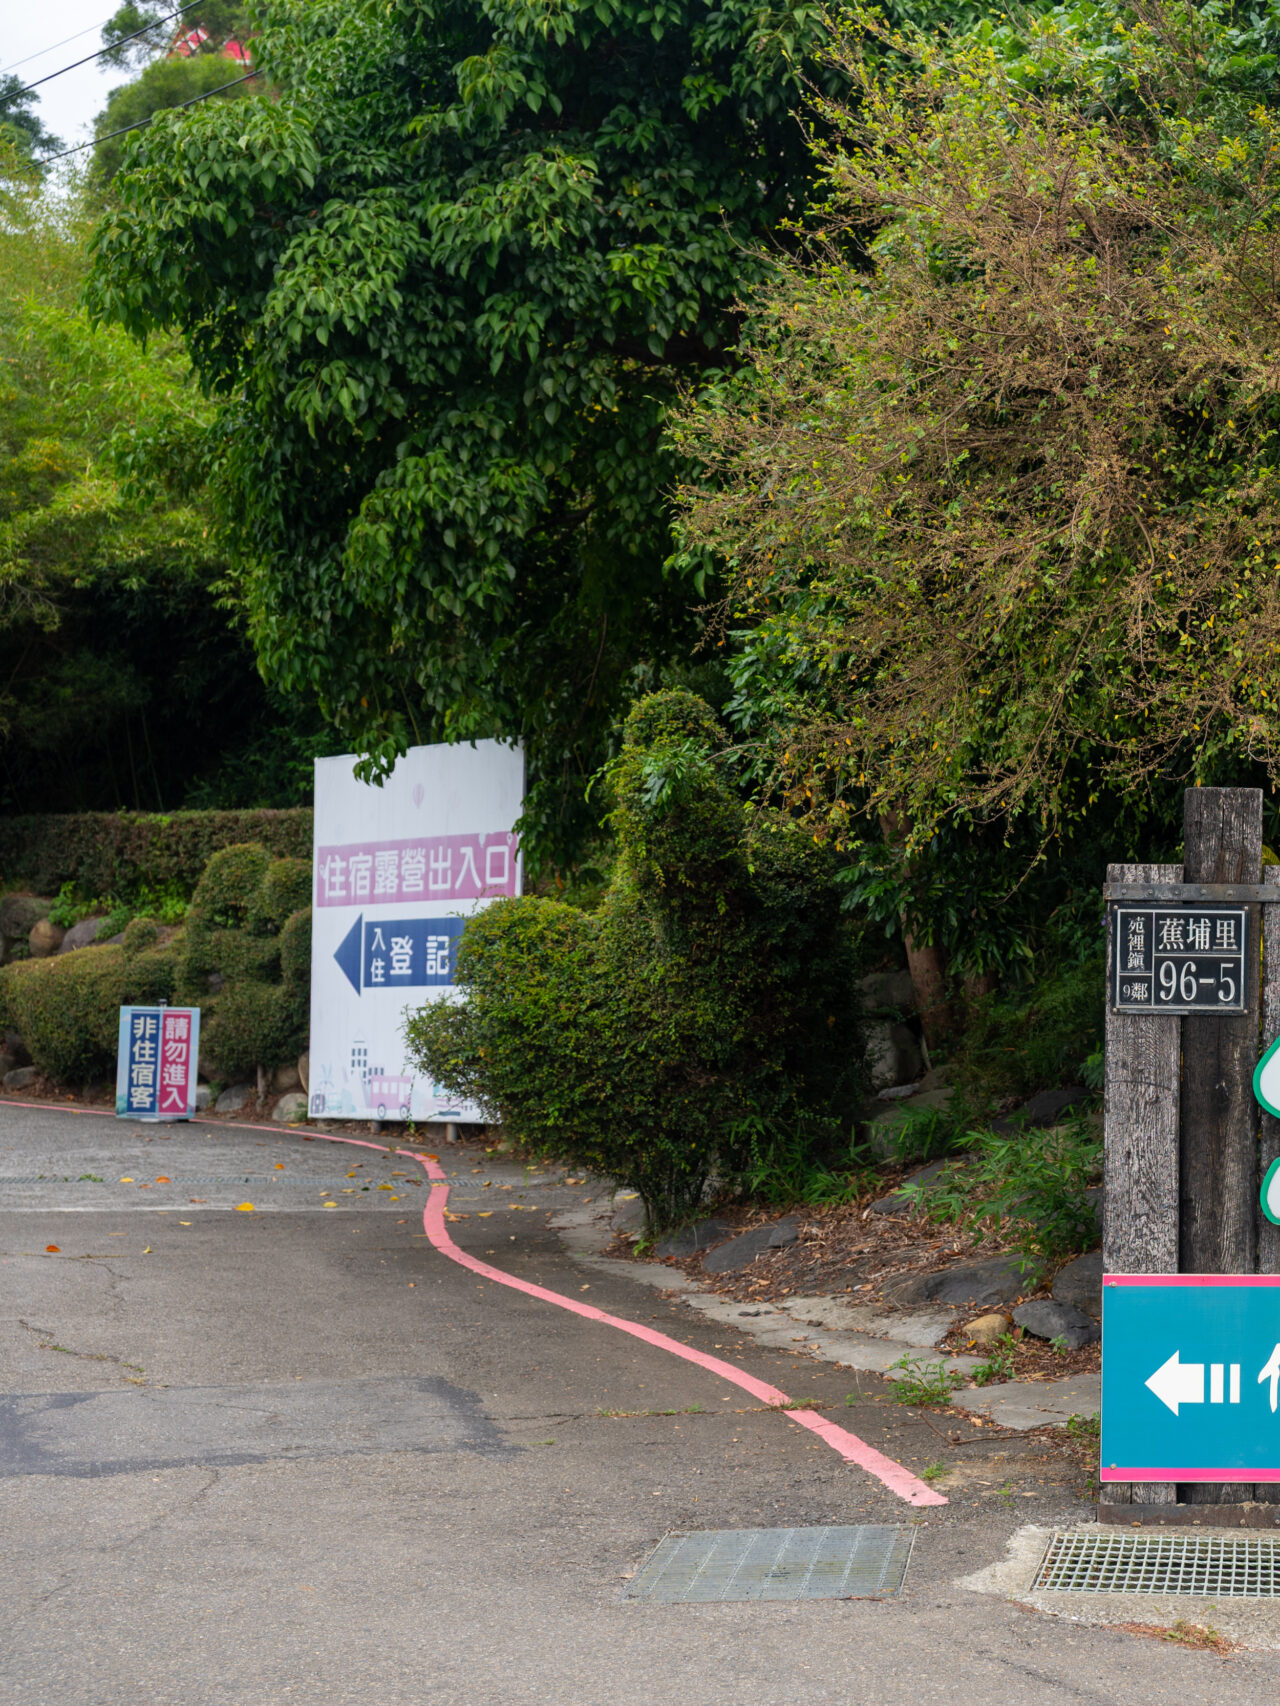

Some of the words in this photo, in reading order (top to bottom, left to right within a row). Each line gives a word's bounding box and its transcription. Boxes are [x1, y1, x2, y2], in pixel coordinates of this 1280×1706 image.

[322, 845, 510, 898] 住宿露營出入口
[370, 927, 386, 983] 入住
[389, 935, 450, 975] 登記
[1127, 916, 1146, 970] 苑裡鎮
[1158, 917, 1238, 951] 蕉埔里
[1159, 960, 1236, 1002] 96-5
[130, 1016, 157, 1109] 非住宿客
[161, 1017, 189, 1109] 請勿進入
